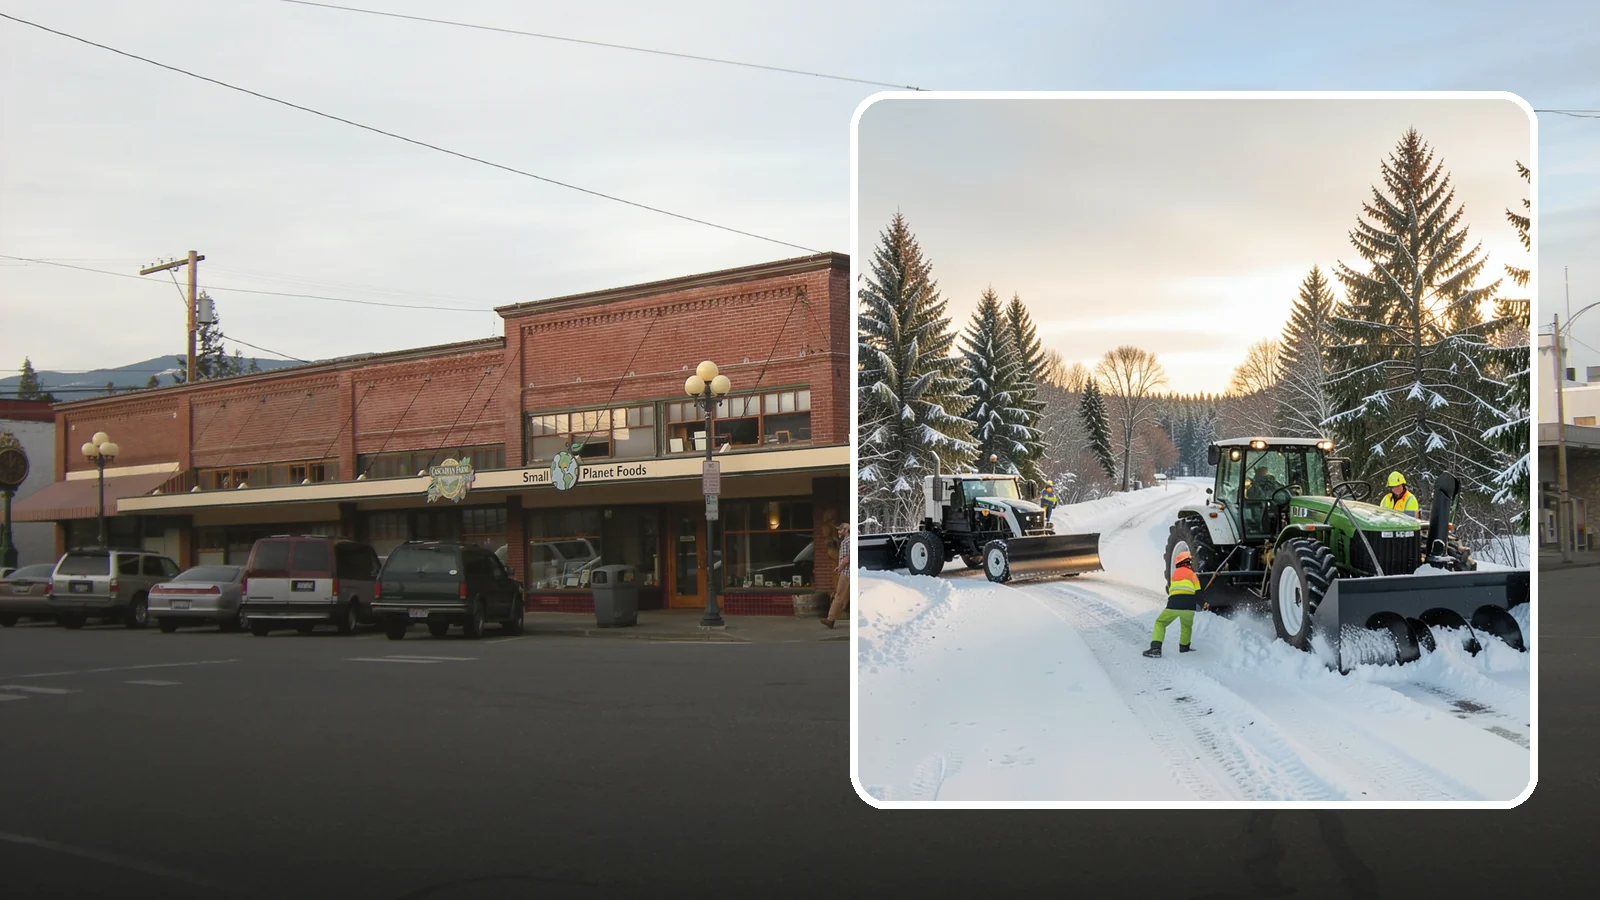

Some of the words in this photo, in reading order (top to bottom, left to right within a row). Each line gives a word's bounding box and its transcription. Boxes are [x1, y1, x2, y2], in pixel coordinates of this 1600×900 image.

[522, 470, 549, 483] Small
[582, 467, 614, 479] Planet
[616, 464, 647, 477] Foods
